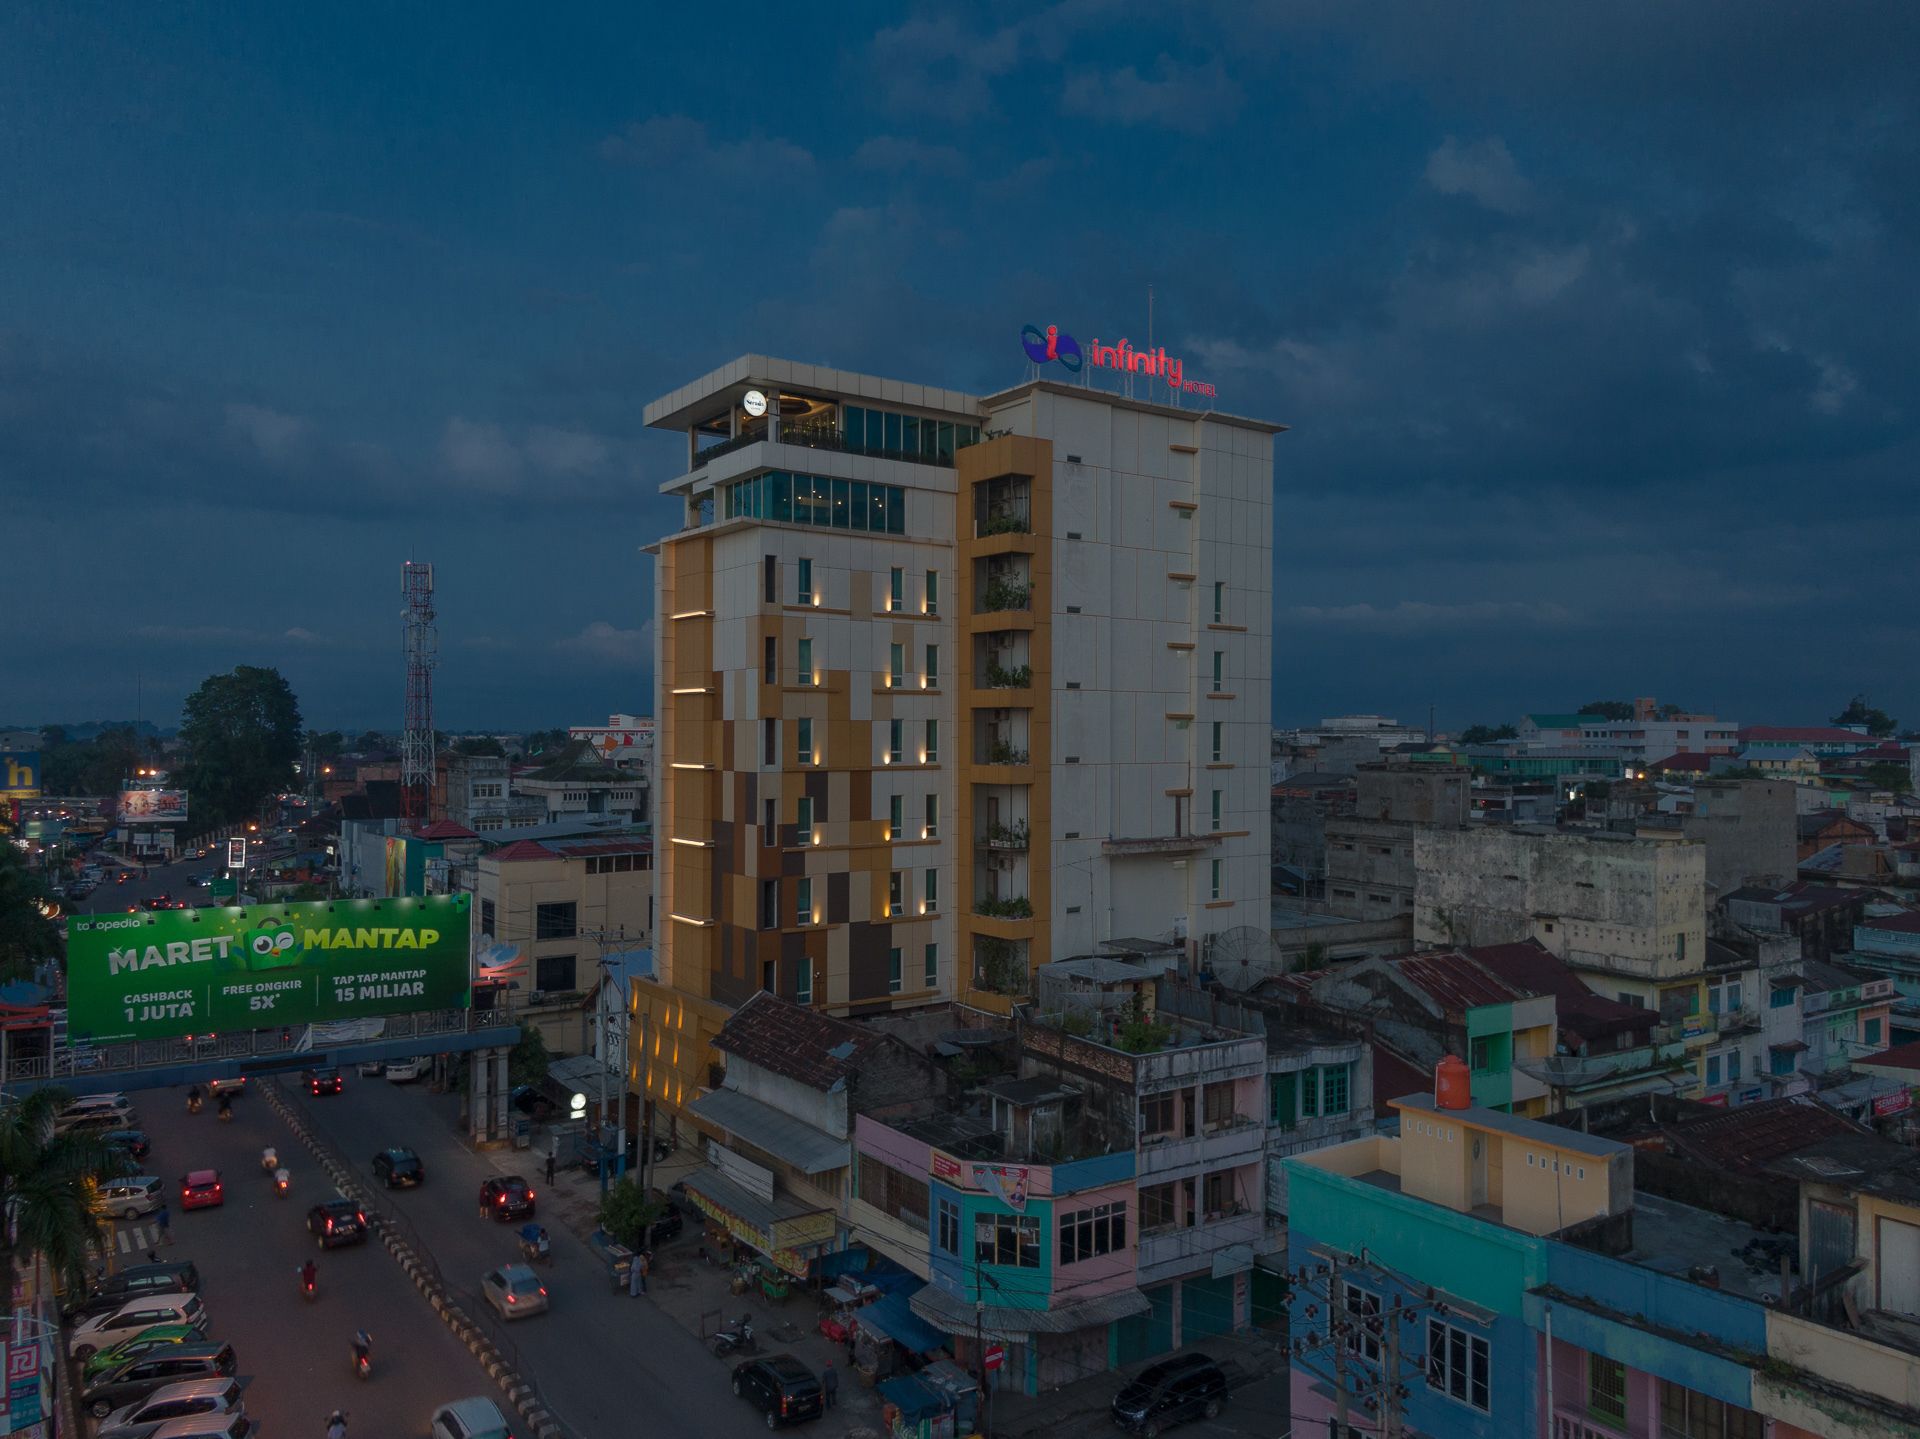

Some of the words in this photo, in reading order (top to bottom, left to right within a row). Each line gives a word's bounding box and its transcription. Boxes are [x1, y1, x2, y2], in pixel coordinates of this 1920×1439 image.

[1093, 338, 1182, 388] infinity
[1183, 380, 1216, 397] HOTEL
[77, 918, 141, 931] toopedia
[108, 935, 235, 976] MARET
[303, 927, 440, 950] MANTAP
[332, 974, 355, 985] TAP
[357, 972, 378, 983] TAP
[380, 968, 427, 982] MANTAP
[223, 983, 253, 996] FREE
[255, 979, 303, 993] ONGKIR
[334, 986, 355, 1003] 15
[359, 980, 425, 1001] MILIAR
[123, 989, 193, 1004] CASHBACK
[124, 1007, 135, 1023] 1
